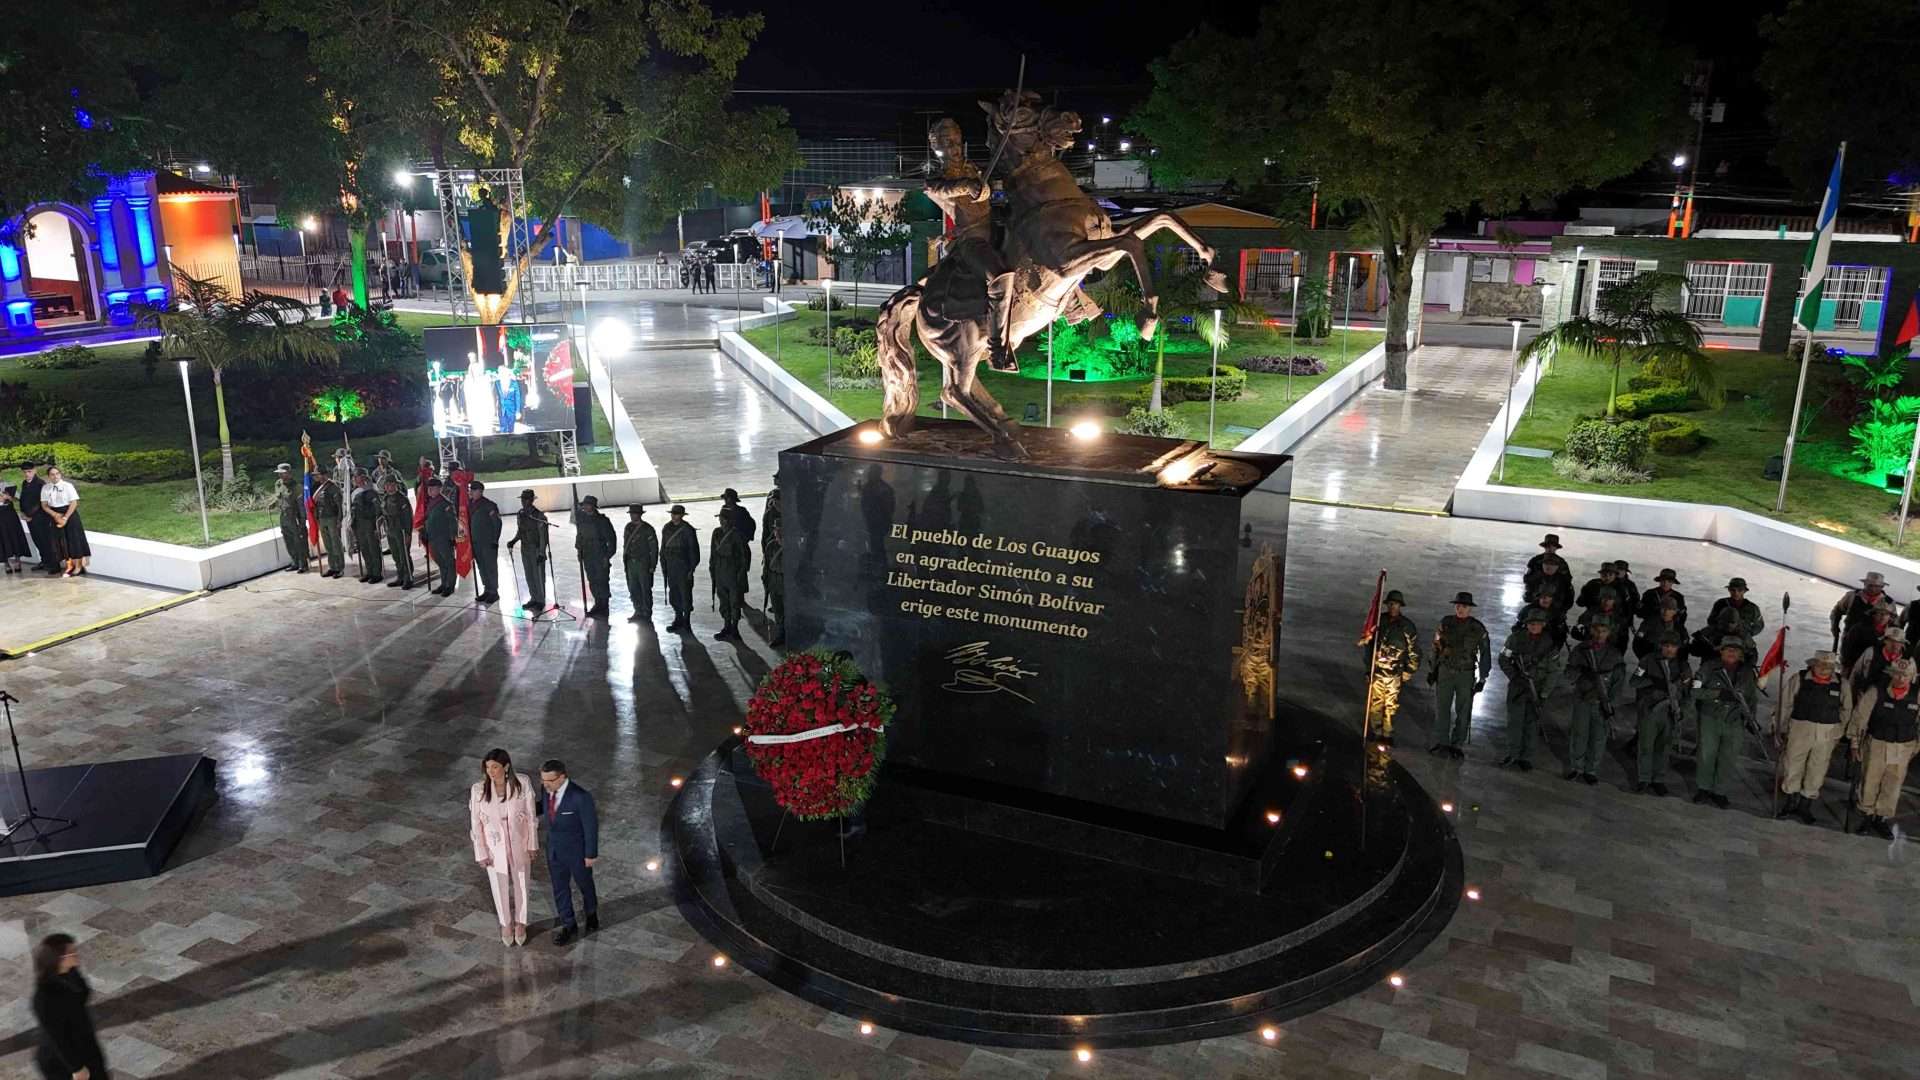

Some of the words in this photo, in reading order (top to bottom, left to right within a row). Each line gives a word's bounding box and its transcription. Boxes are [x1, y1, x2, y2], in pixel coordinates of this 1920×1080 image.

[890, 523, 908, 540] El
[910, 529, 968, 546] pueblo
[971, 533, 993, 550] de
[996, 536, 1028, 555] Los
[1031, 540, 1101, 565] Guayos
[895, 552, 915, 565] en
[919, 554, 1052, 583] agradecimiento
[1055, 573, 1068, 586] a
[1071, 575, 1095, 589] su
[887, 571, 976, 597] Libertador
[978, 584, 1035, 606] Simón
[1038, 592, 1105, 616] Bolívar
[901, 598, 943, 619] erige
[945, 606, 980, 623] este
[983, 612, 1089, 639] monumento
